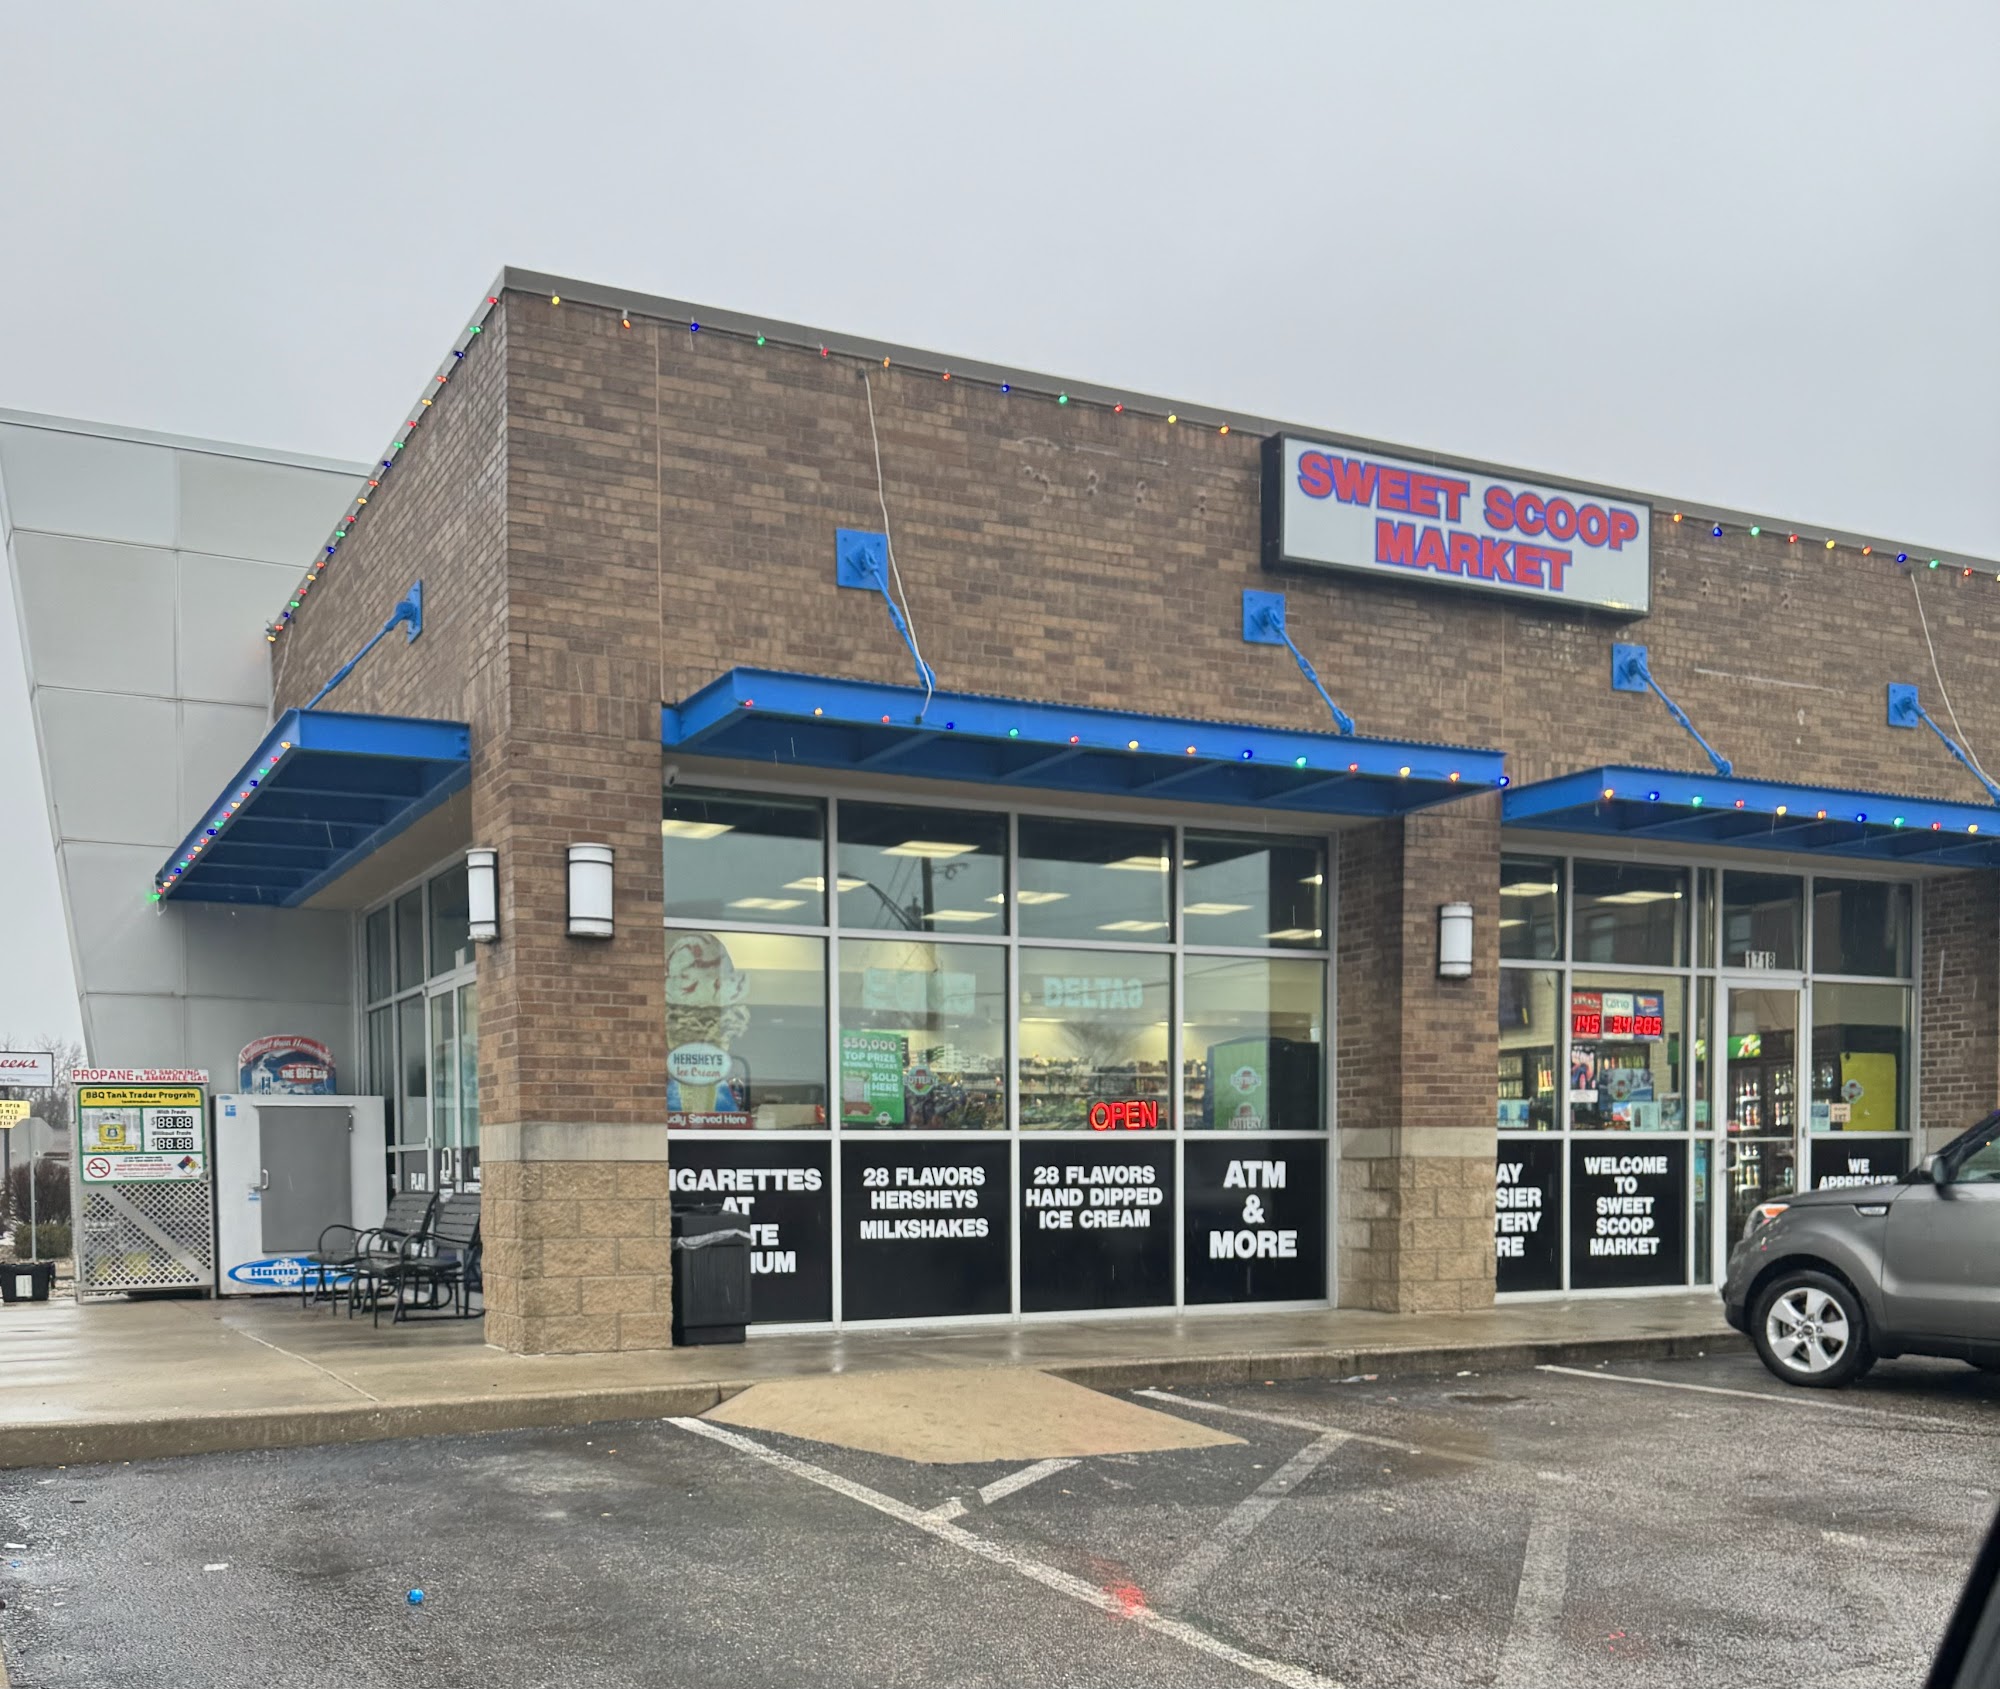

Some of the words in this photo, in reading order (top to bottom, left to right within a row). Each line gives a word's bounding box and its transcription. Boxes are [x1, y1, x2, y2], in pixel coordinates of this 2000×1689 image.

[1298, 450, 1470, 524] SWEET
[1484, 485, 1639, 552] SCOOP
[1375, 516, 1572, 592] MARKET
[1575, 1015, 1600, 1034] 145
[1612, 1015, 1632, 1034] 34
[1634, 1015, 1662, 1035] 285
[842, 1036, 897, 1052] $50,000
[844, 1050, 865, 1061] TOP
[867, 1052, 896, 1063] PRIZE
[72, 1069, 134, 1081] PROPANE
[159, 1069, 200, 1077] SMOKING
[296, 1067, 312, 1079] BIG
[871, 1072, 899, 1082] SOLD
[86, 1091, 105, 1099] BBQ
[106, 1091, 127, 1099] Tank
[129, 1091, 157, 1099] Trader
[159, 1091, 196, 1100] Program
[871, 1082, 899, 1092] HERE
[688, 1114, 723, 1124] Served
[724, 1115, 747, 1124] Here
[1090, 1101, 1157, 1131] OPEN
[1033, 1166, 1060, 1185] 28
[1066, 1165, 1156, 1184] FLAVORS
[1223, 1160, 1286, 1188] ATM
[1584, 1156, 1668, 1175] WELCOME
[1848, 1158, 1870, 1174] WE
[668, 1168, 822, 1191] IGARETTES
[863, 1167, 890, 1187] 28
[896, 1166, 986, 1186] FLAVORS
[1614, 1176, 1638, 1194] TO
[871, 1189, 978, 1209] HERSHEYS
[1025, 1188, 1084, 1207] HAND
[1089, 1187, 1163, 1206] DIPPED
[1495, 1187, 1542, 1208] SIER
[1596, 1197, 1655, 1215] SWEET
[1242, 1194, 1265, 1223] &
[860, 1218, 989, 1239] MILKSHAKES
[1039, 1210, 1074, 1229] ICE
[1079, 1209, 1151, 1228] CREAM
[1596, 1217, 1655, 1236] SCOOP
[1209, 1229, 1298, 1259] MORE
[1589, 1237, 1660, 1256] MARKET
[251, 1268, 299, 1276] Home
